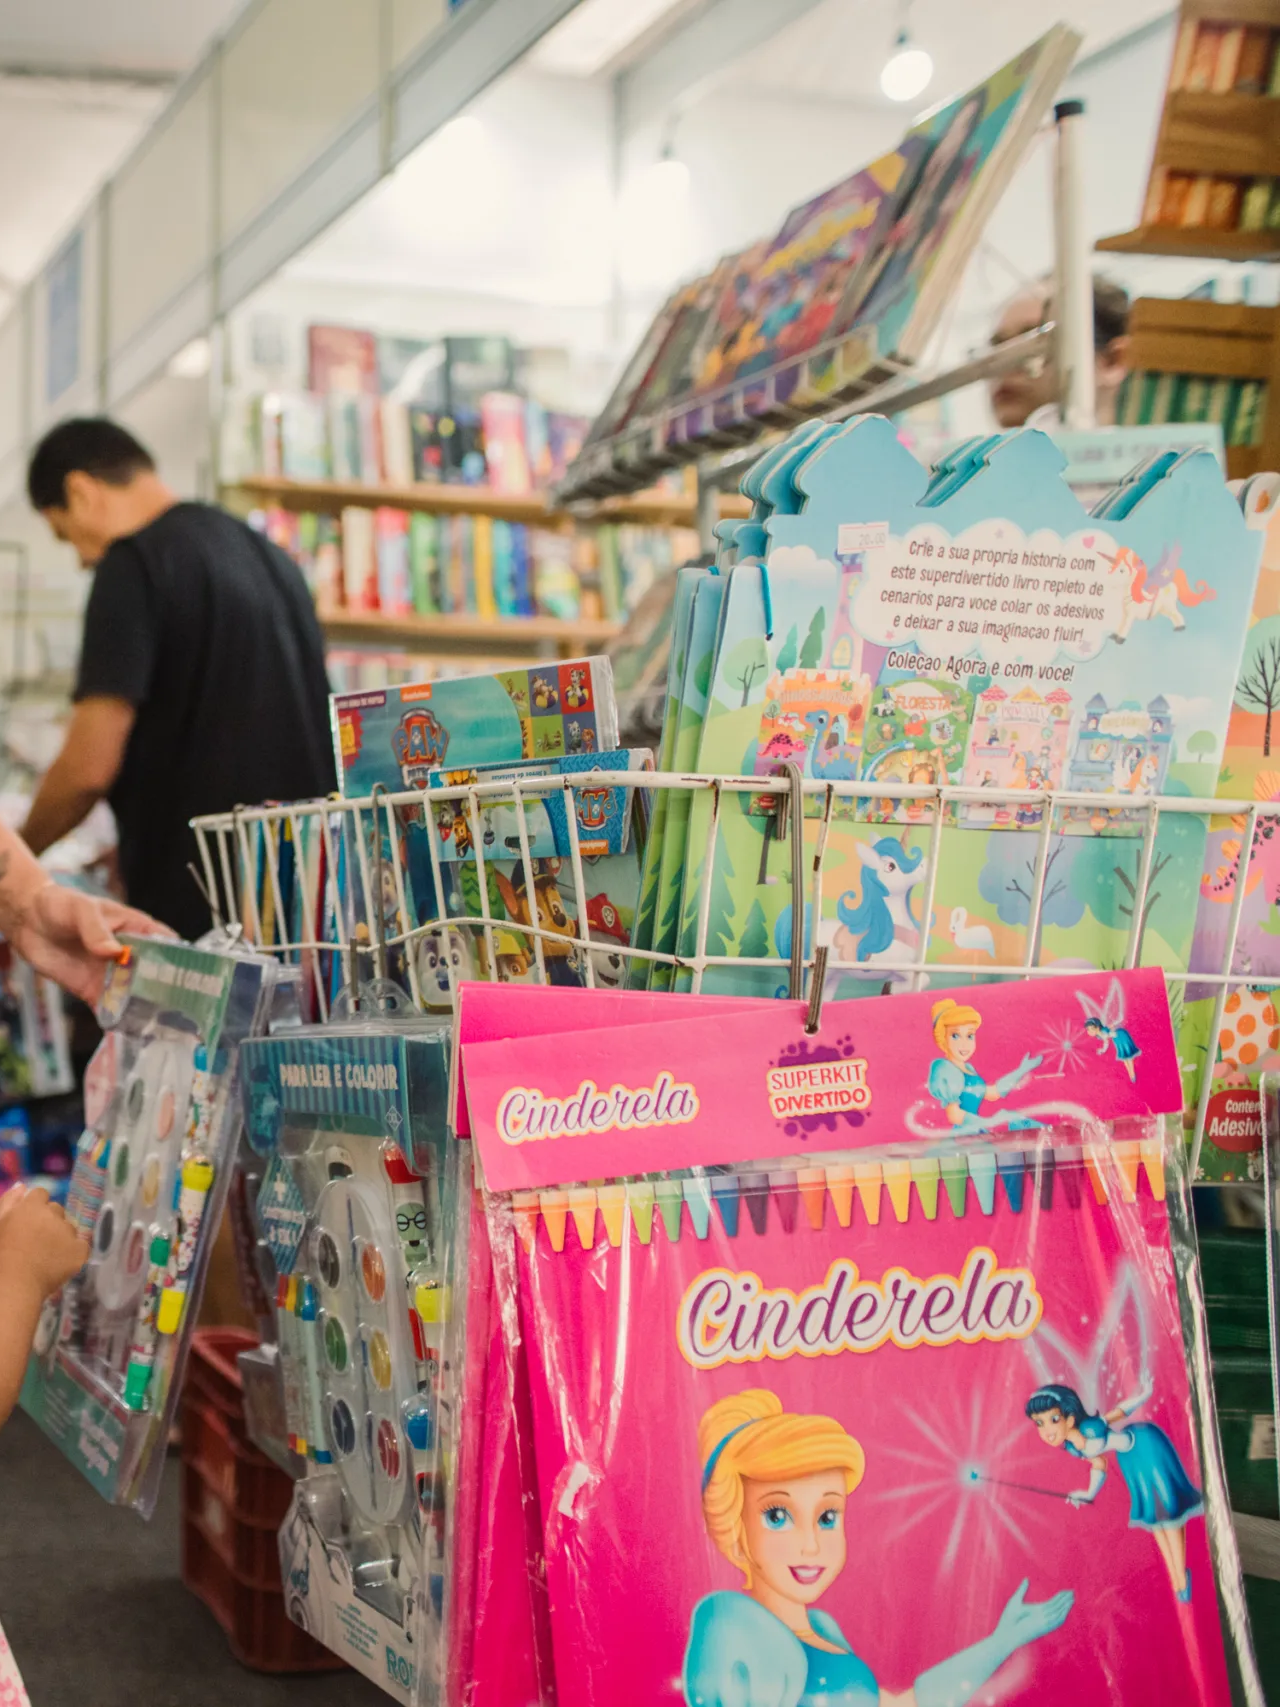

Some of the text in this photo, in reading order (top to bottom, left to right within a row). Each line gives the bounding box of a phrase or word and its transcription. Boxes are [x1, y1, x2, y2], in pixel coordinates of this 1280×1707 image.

[909, 540, 934, 557] Crie
[937, 545, 945, 558] a
[948, 546, 970, 560] sua
[1070, 557, 1095, 572] com
[890, 564, 1104, 597] este superdivertido livro repleto de
[936, 593, 965, 612] para
[1000, 599, 1033, 615] colar
[1036, 602, 1051, 616] os
[1053, 602, 1105, 621] adesivos
[893, 614, 901, 628] e
[904, 614, 943, 631] deixar
[946, 619, 955, 632] a
[958, 620, 979, 634] sua
[1053, 626, 1084, 643] fluir!
[945, 655, 987, 681] Agora
[1004, 663, 1034, 679] com
[391, 724, 451, 767] PAW
[279, 1063, 399, 1090] PARA LER E COLORIR
[770, 1063, 864, 1092] SUPERKIT
[501, 1075, 694, 1140] Cinderela
[774, 1086, 866, 1114] DIVERTIDO
[688, 1257, 1032, 1358] Cinderela
